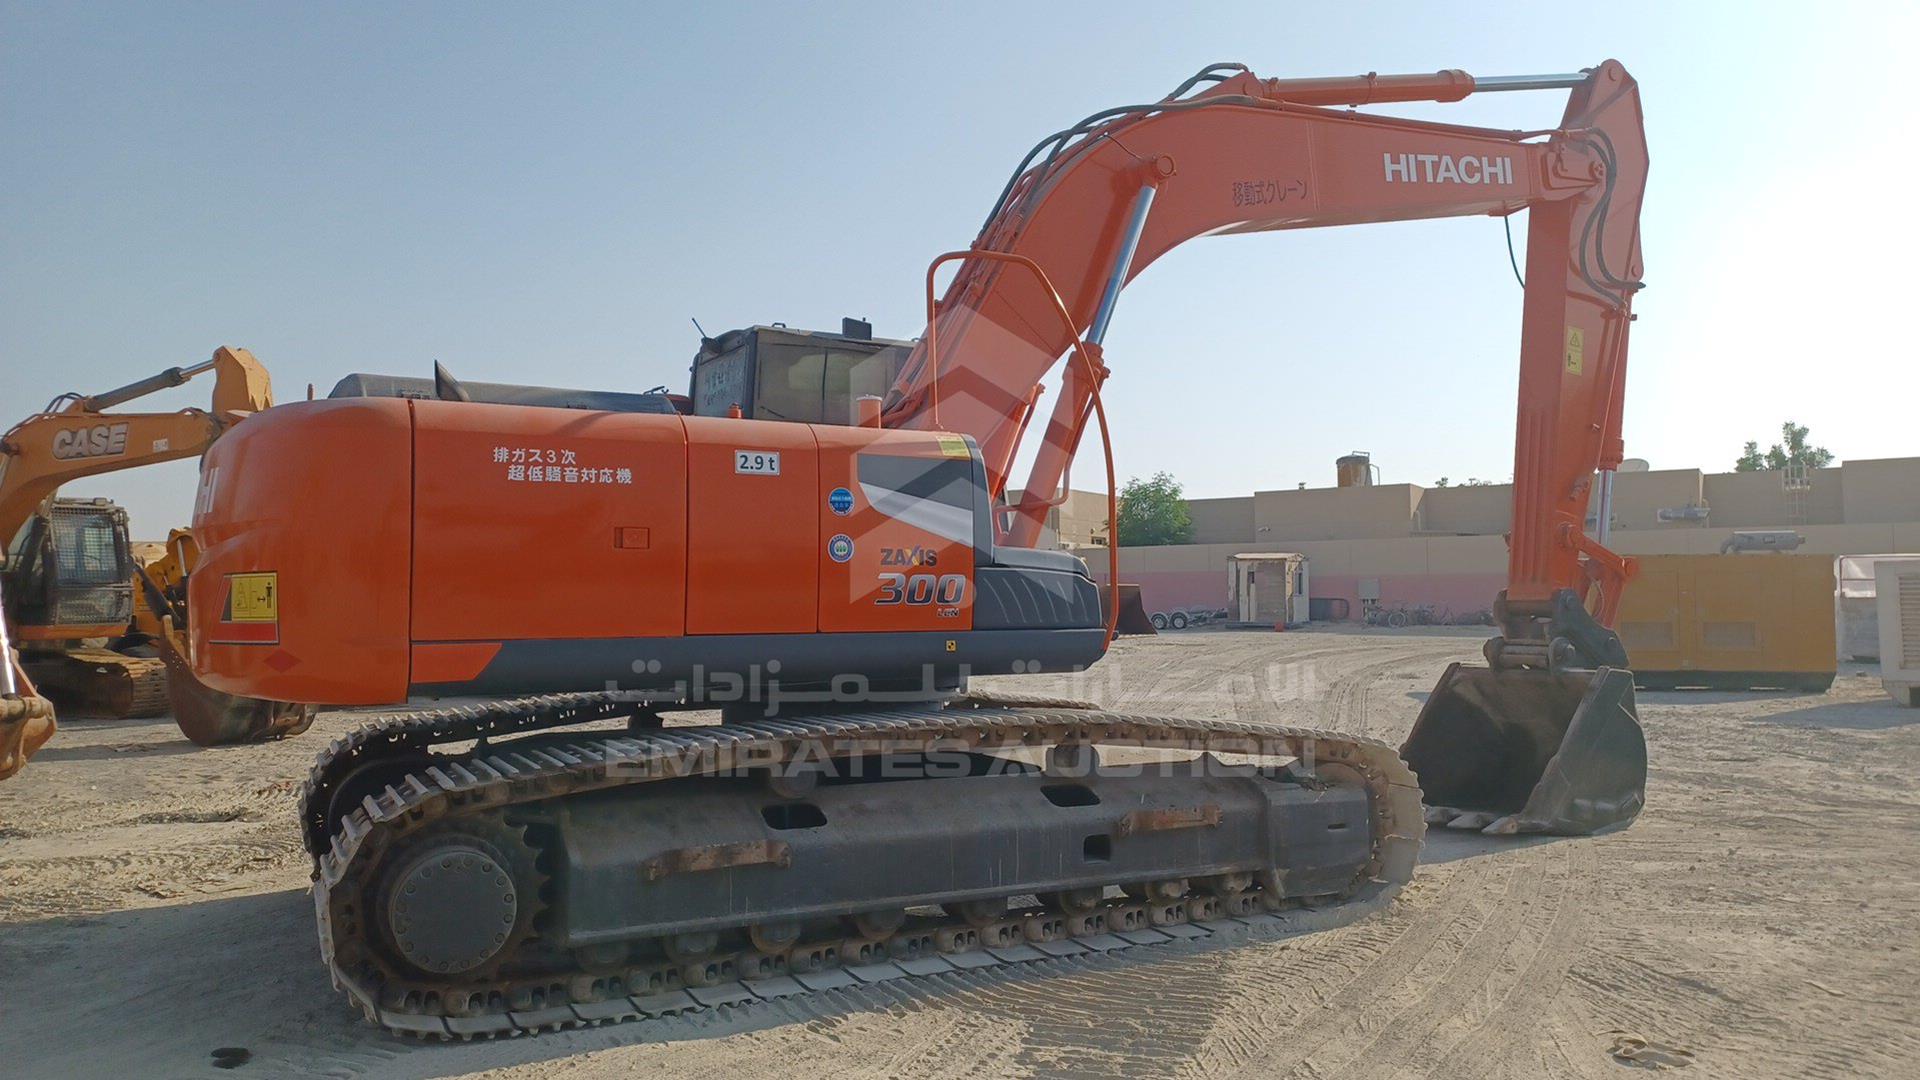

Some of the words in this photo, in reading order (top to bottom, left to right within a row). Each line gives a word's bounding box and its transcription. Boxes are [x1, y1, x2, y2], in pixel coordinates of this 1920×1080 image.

[1383, 152, 1514, 185] HITACHI
[1232, 180, 1308, 208] 移動式クレーン
[52, 422, 129, 459] CASE
[507, 464, 633, 484] 超低騒音対応機
[880, 545, 938, 567] ZAXIS
[874, 572, 967, 606] 300
